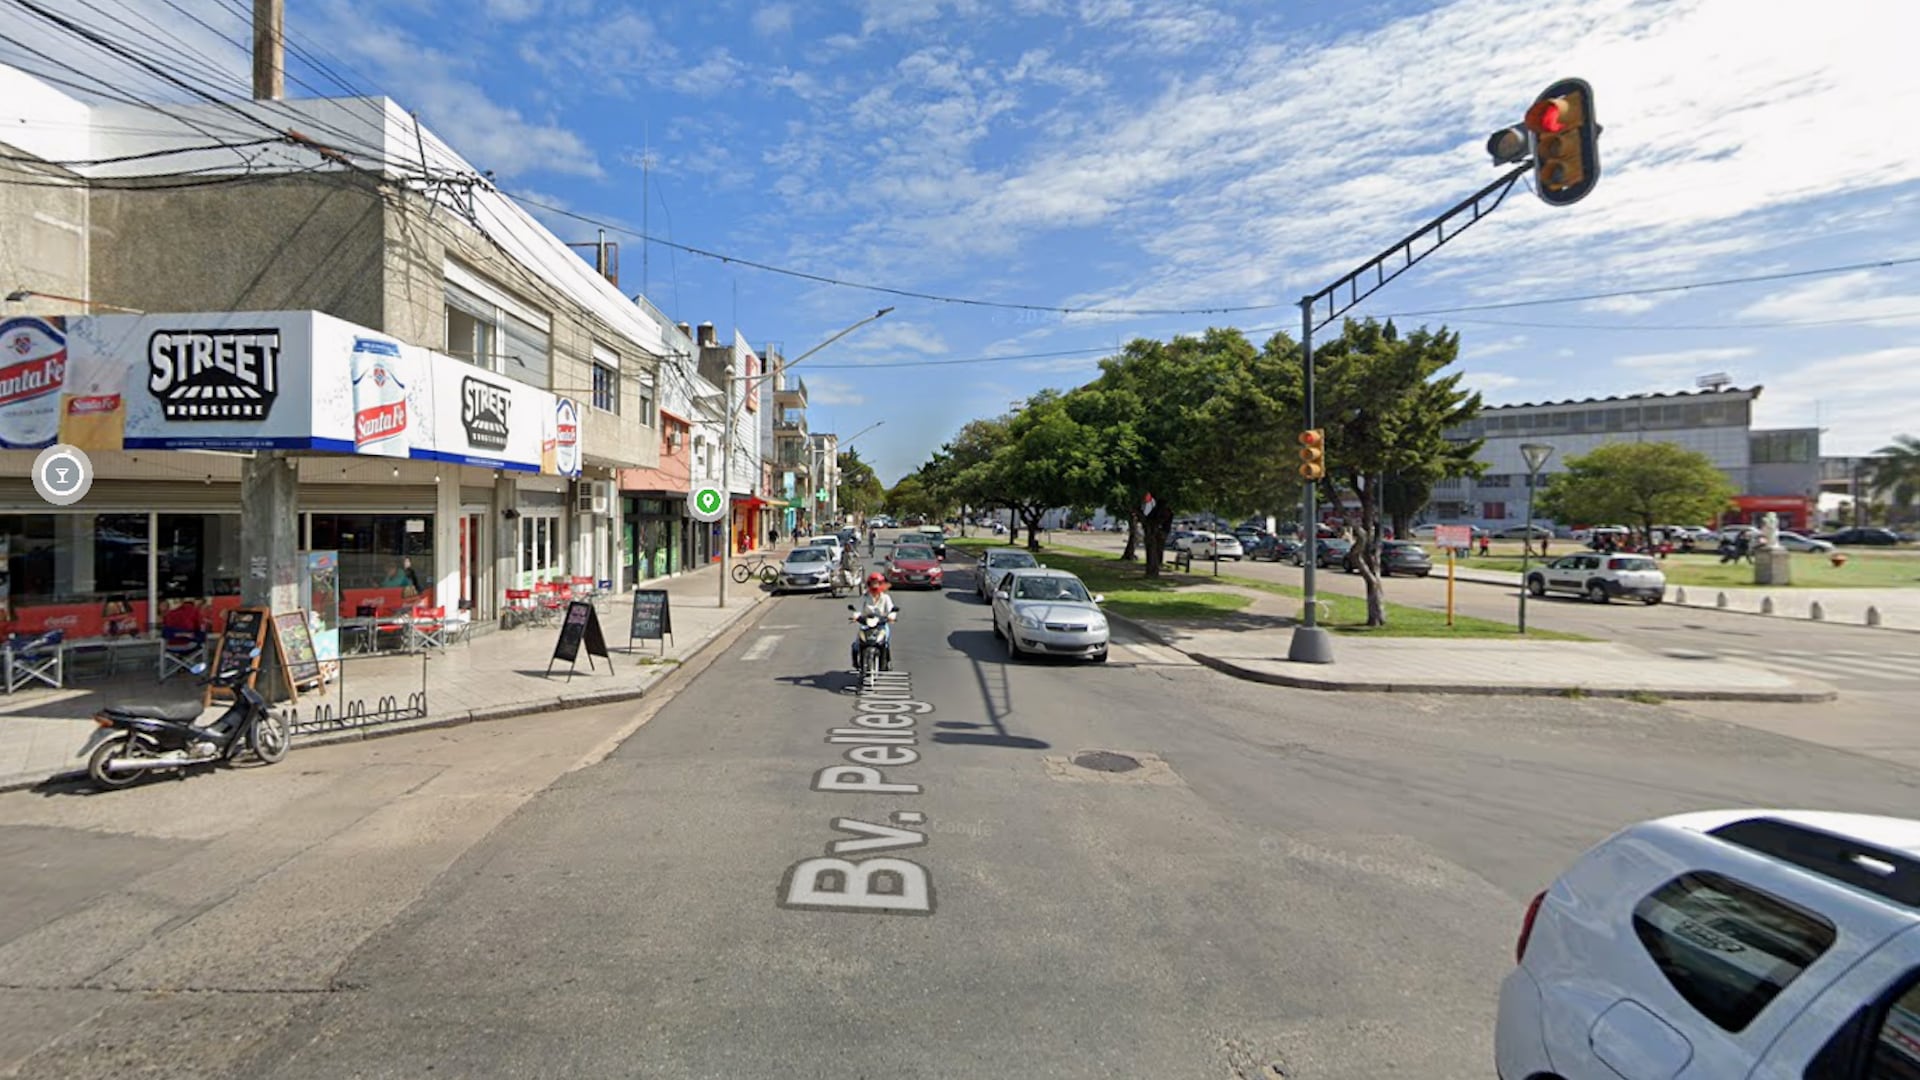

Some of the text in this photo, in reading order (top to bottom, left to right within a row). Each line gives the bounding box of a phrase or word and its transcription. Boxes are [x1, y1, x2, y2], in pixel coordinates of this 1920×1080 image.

[0, 369, 42, 397] anta
[149, 333, 279, 393] STREET
[464, 378, 511, 430] STREET
[358, 411, 392, 440] Santa
